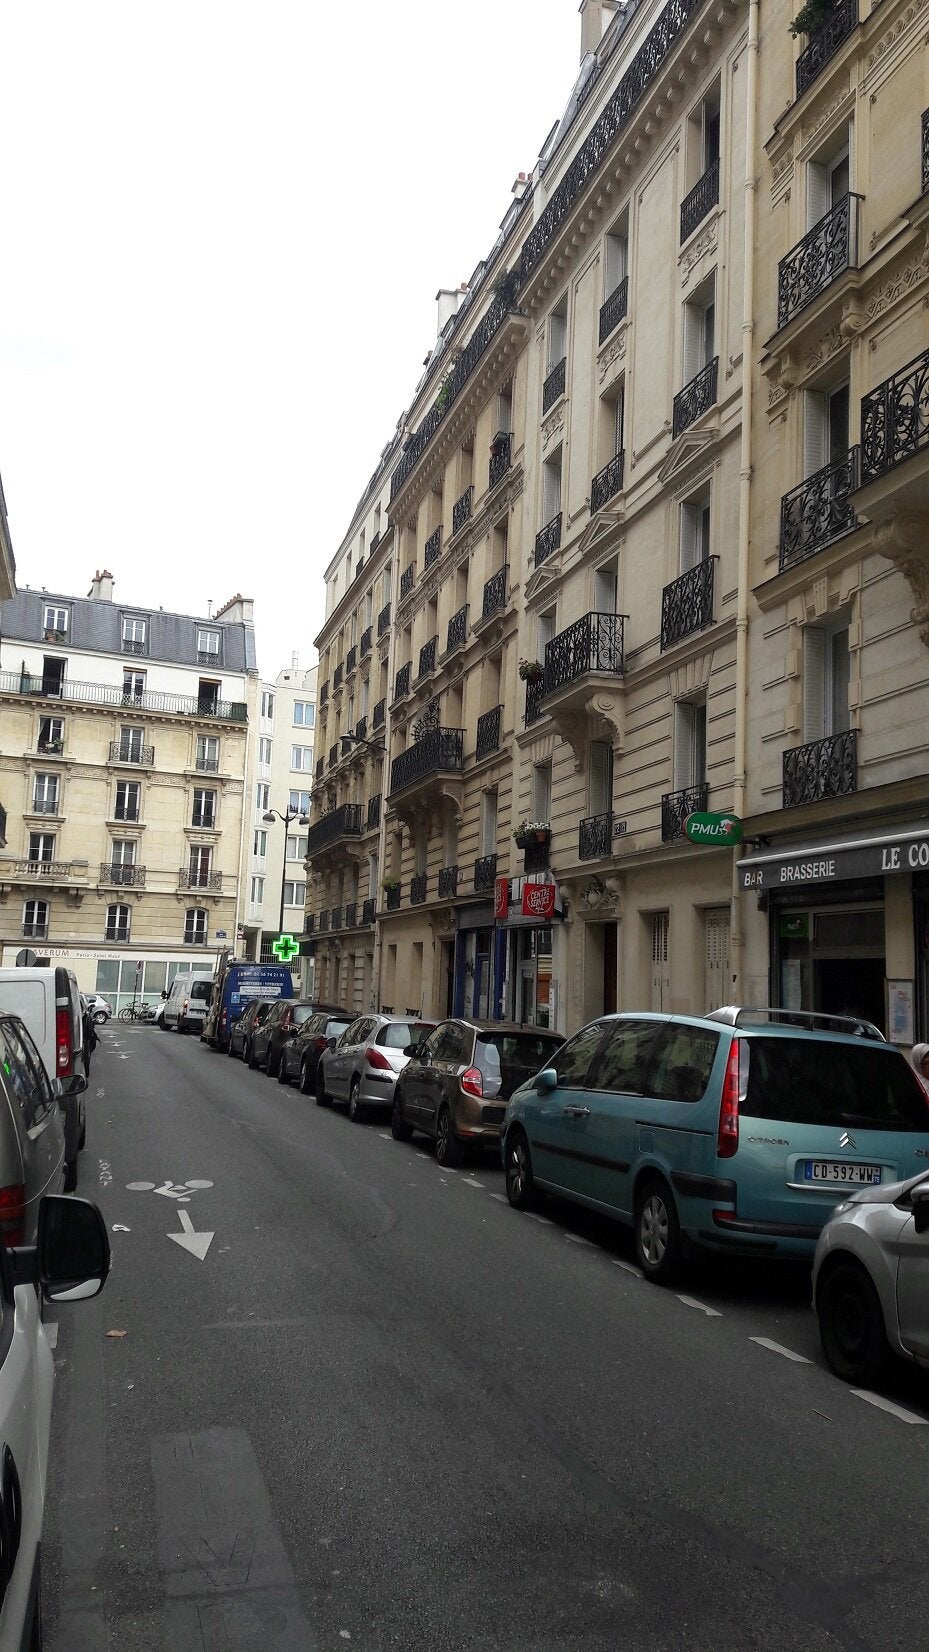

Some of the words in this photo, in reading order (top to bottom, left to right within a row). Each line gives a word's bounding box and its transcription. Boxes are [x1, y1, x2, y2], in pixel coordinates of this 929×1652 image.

[690, 822, 720, 835] PMU
[744, 870, 764, 886] BAR
[780, 859, 836, 882] BRASSERIE
[881, 847, 901, 870] LE
[813, 1162, 874, 1182] CD-592-WW
